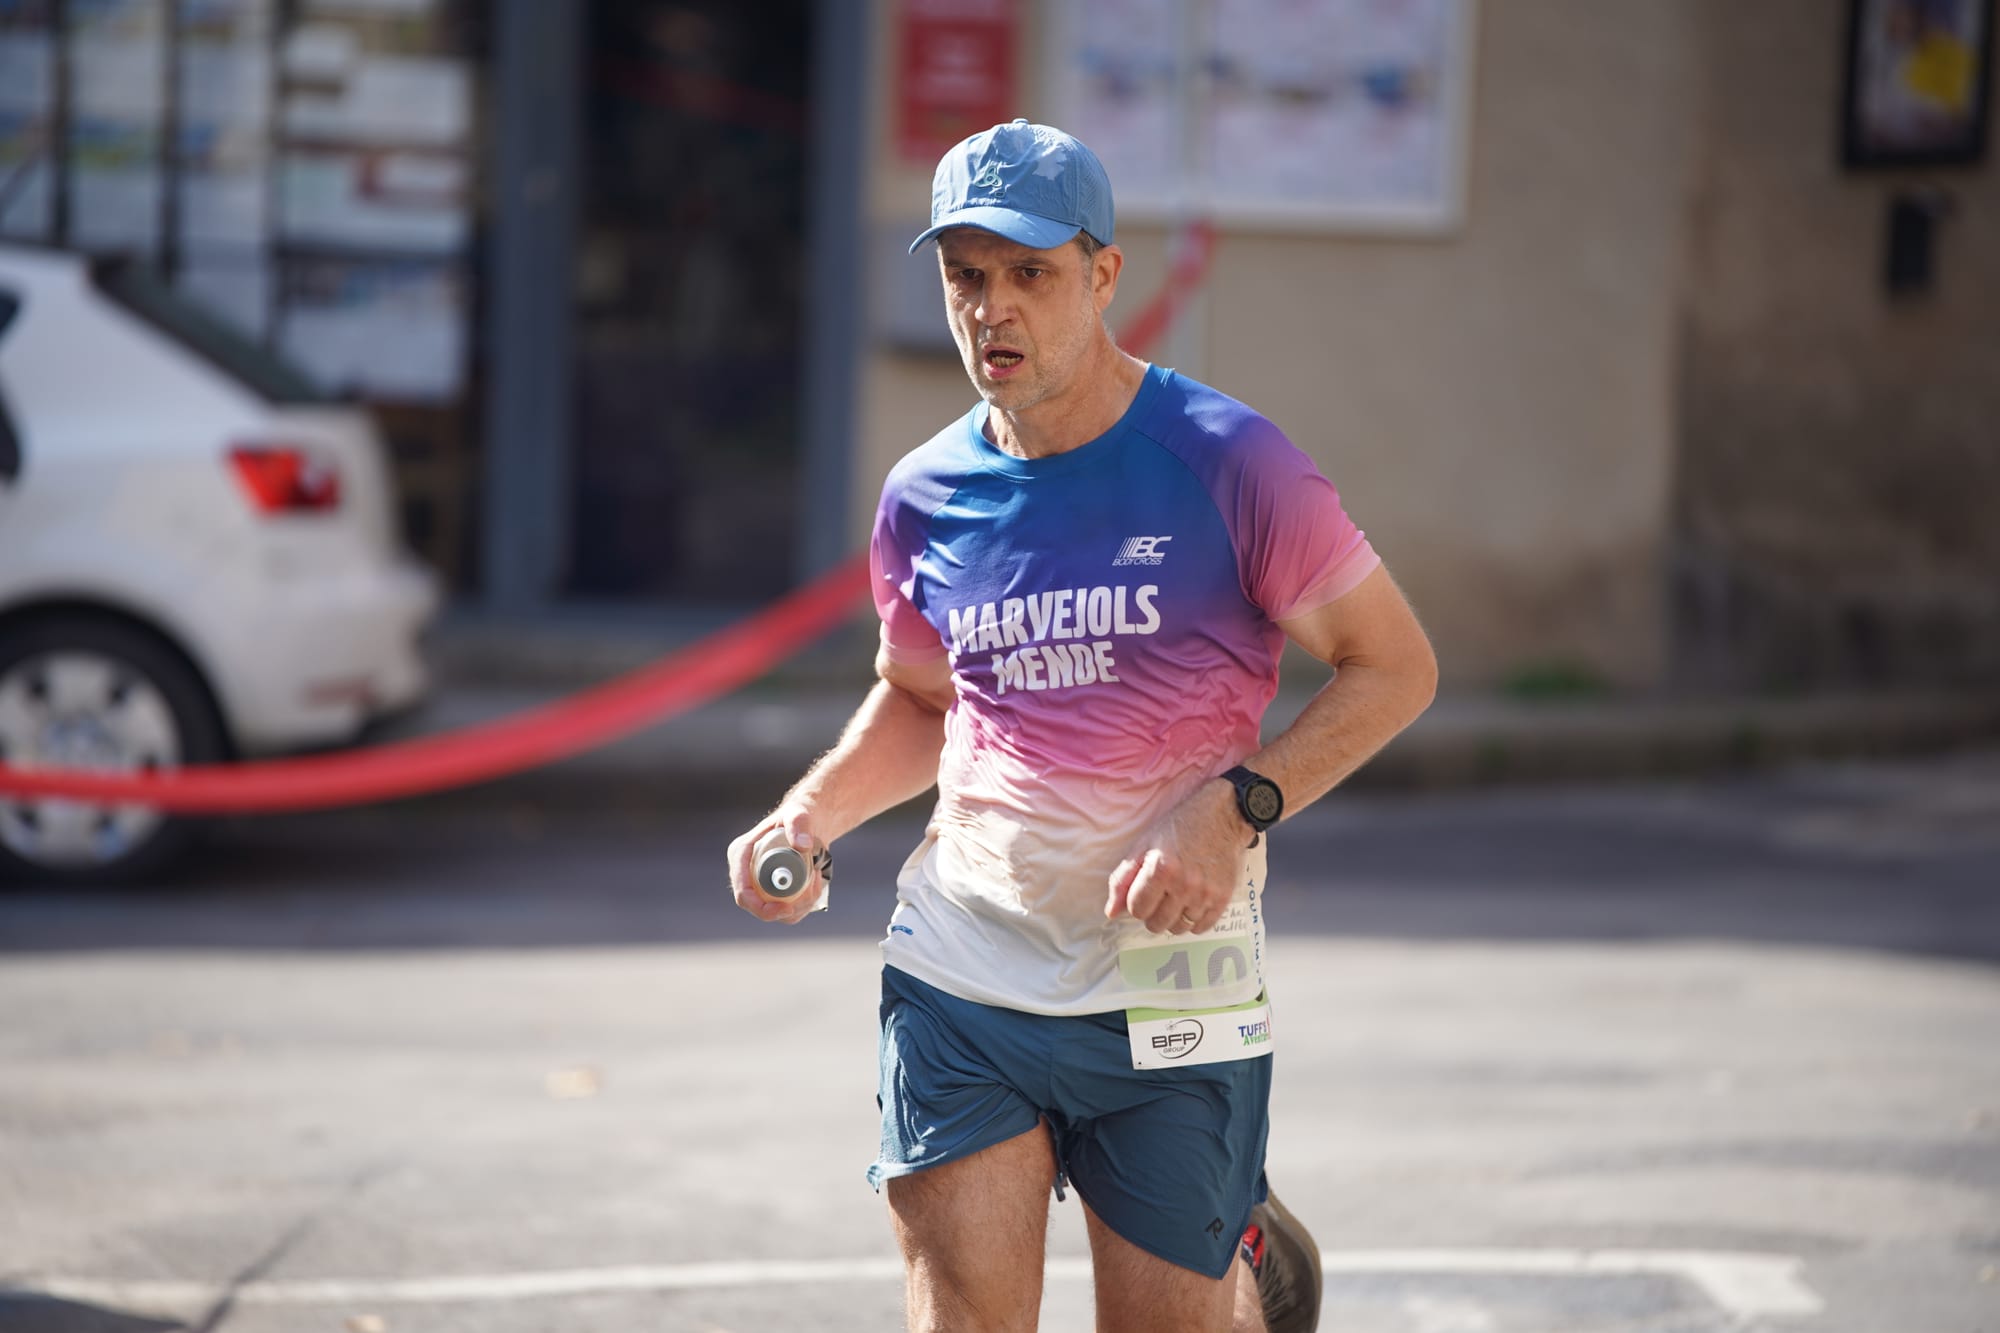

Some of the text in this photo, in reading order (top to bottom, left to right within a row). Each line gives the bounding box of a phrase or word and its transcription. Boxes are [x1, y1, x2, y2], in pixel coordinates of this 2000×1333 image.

[948, 584, 1161, 656] MARVEJOLS
[991, 641, 1120, 695] MENDE
[1152, 1032, 1197, 1049] BFP
[1162, 1046, 1186, 1054] GROUP
